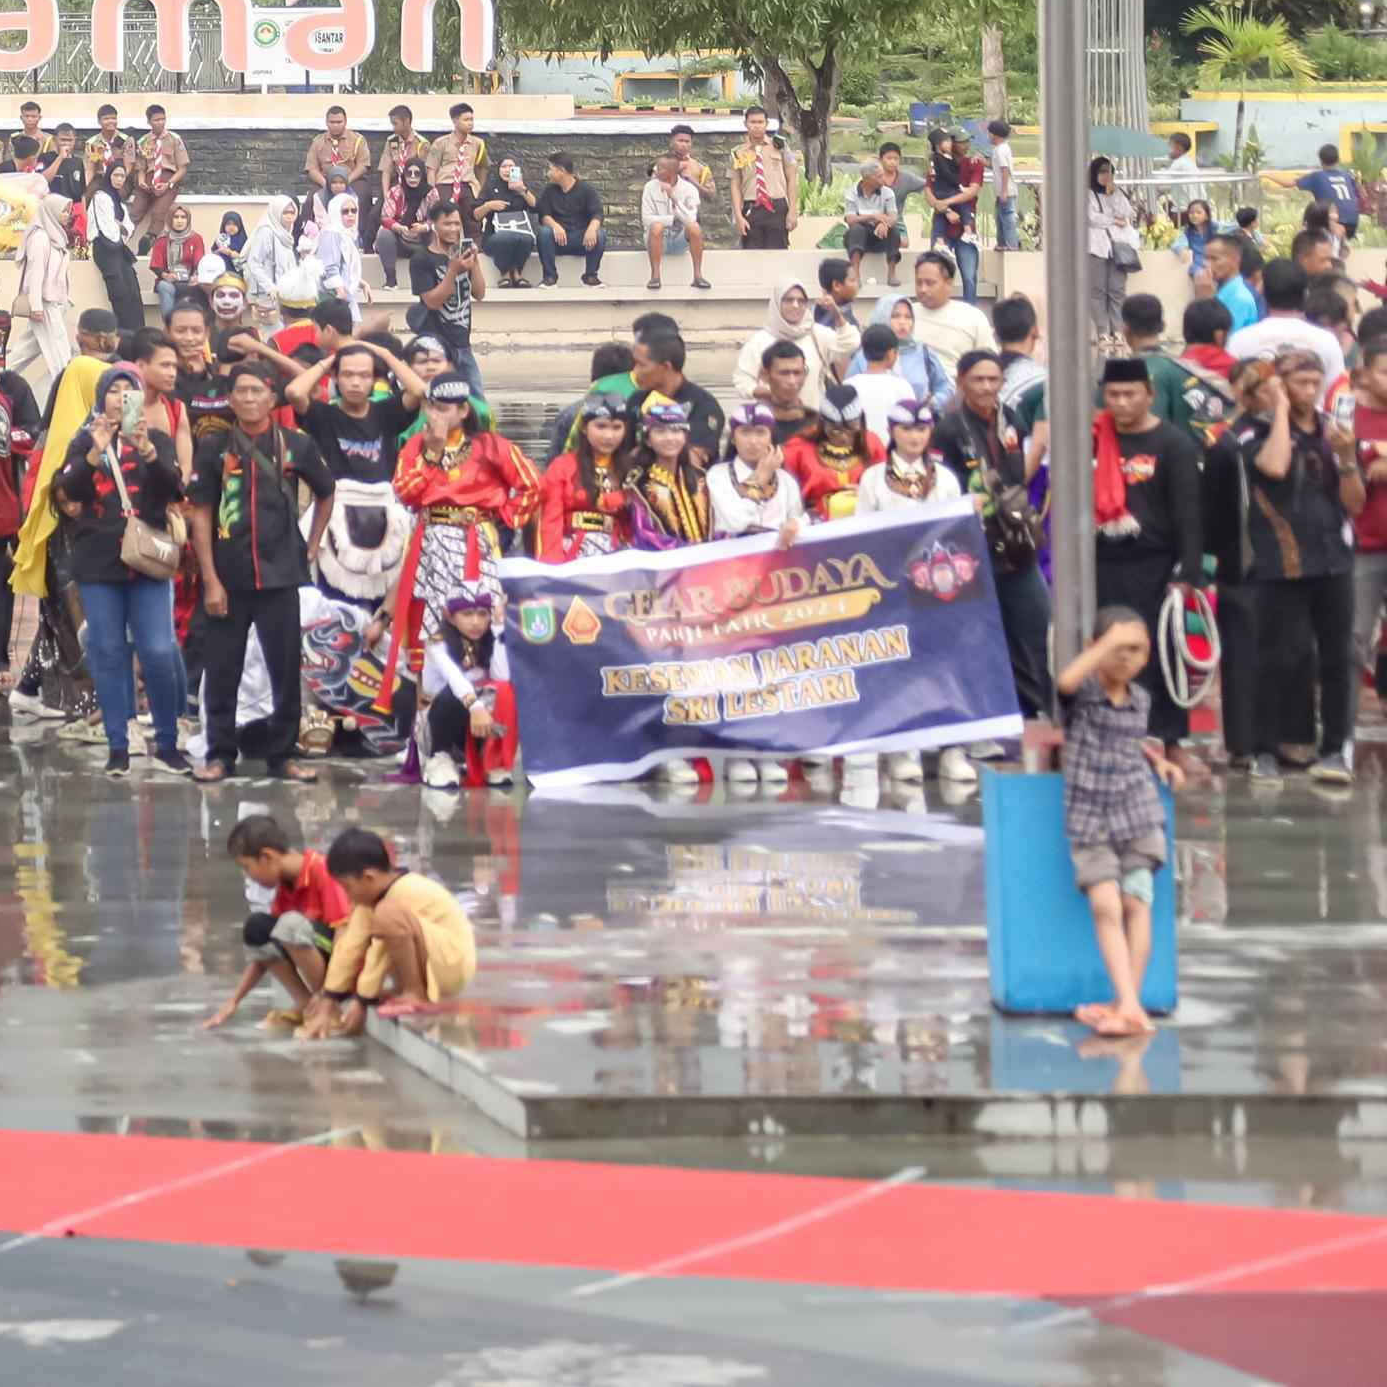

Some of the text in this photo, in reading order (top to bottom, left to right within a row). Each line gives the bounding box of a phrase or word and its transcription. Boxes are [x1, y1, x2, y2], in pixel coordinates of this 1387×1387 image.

[315, 32, 344, 44] SANTAR
[725, 553, 897, 611] BUDAYA
[758, 624, 911, 687] JARANAN
[663, 669, 860, 725] SRI LESTARI
